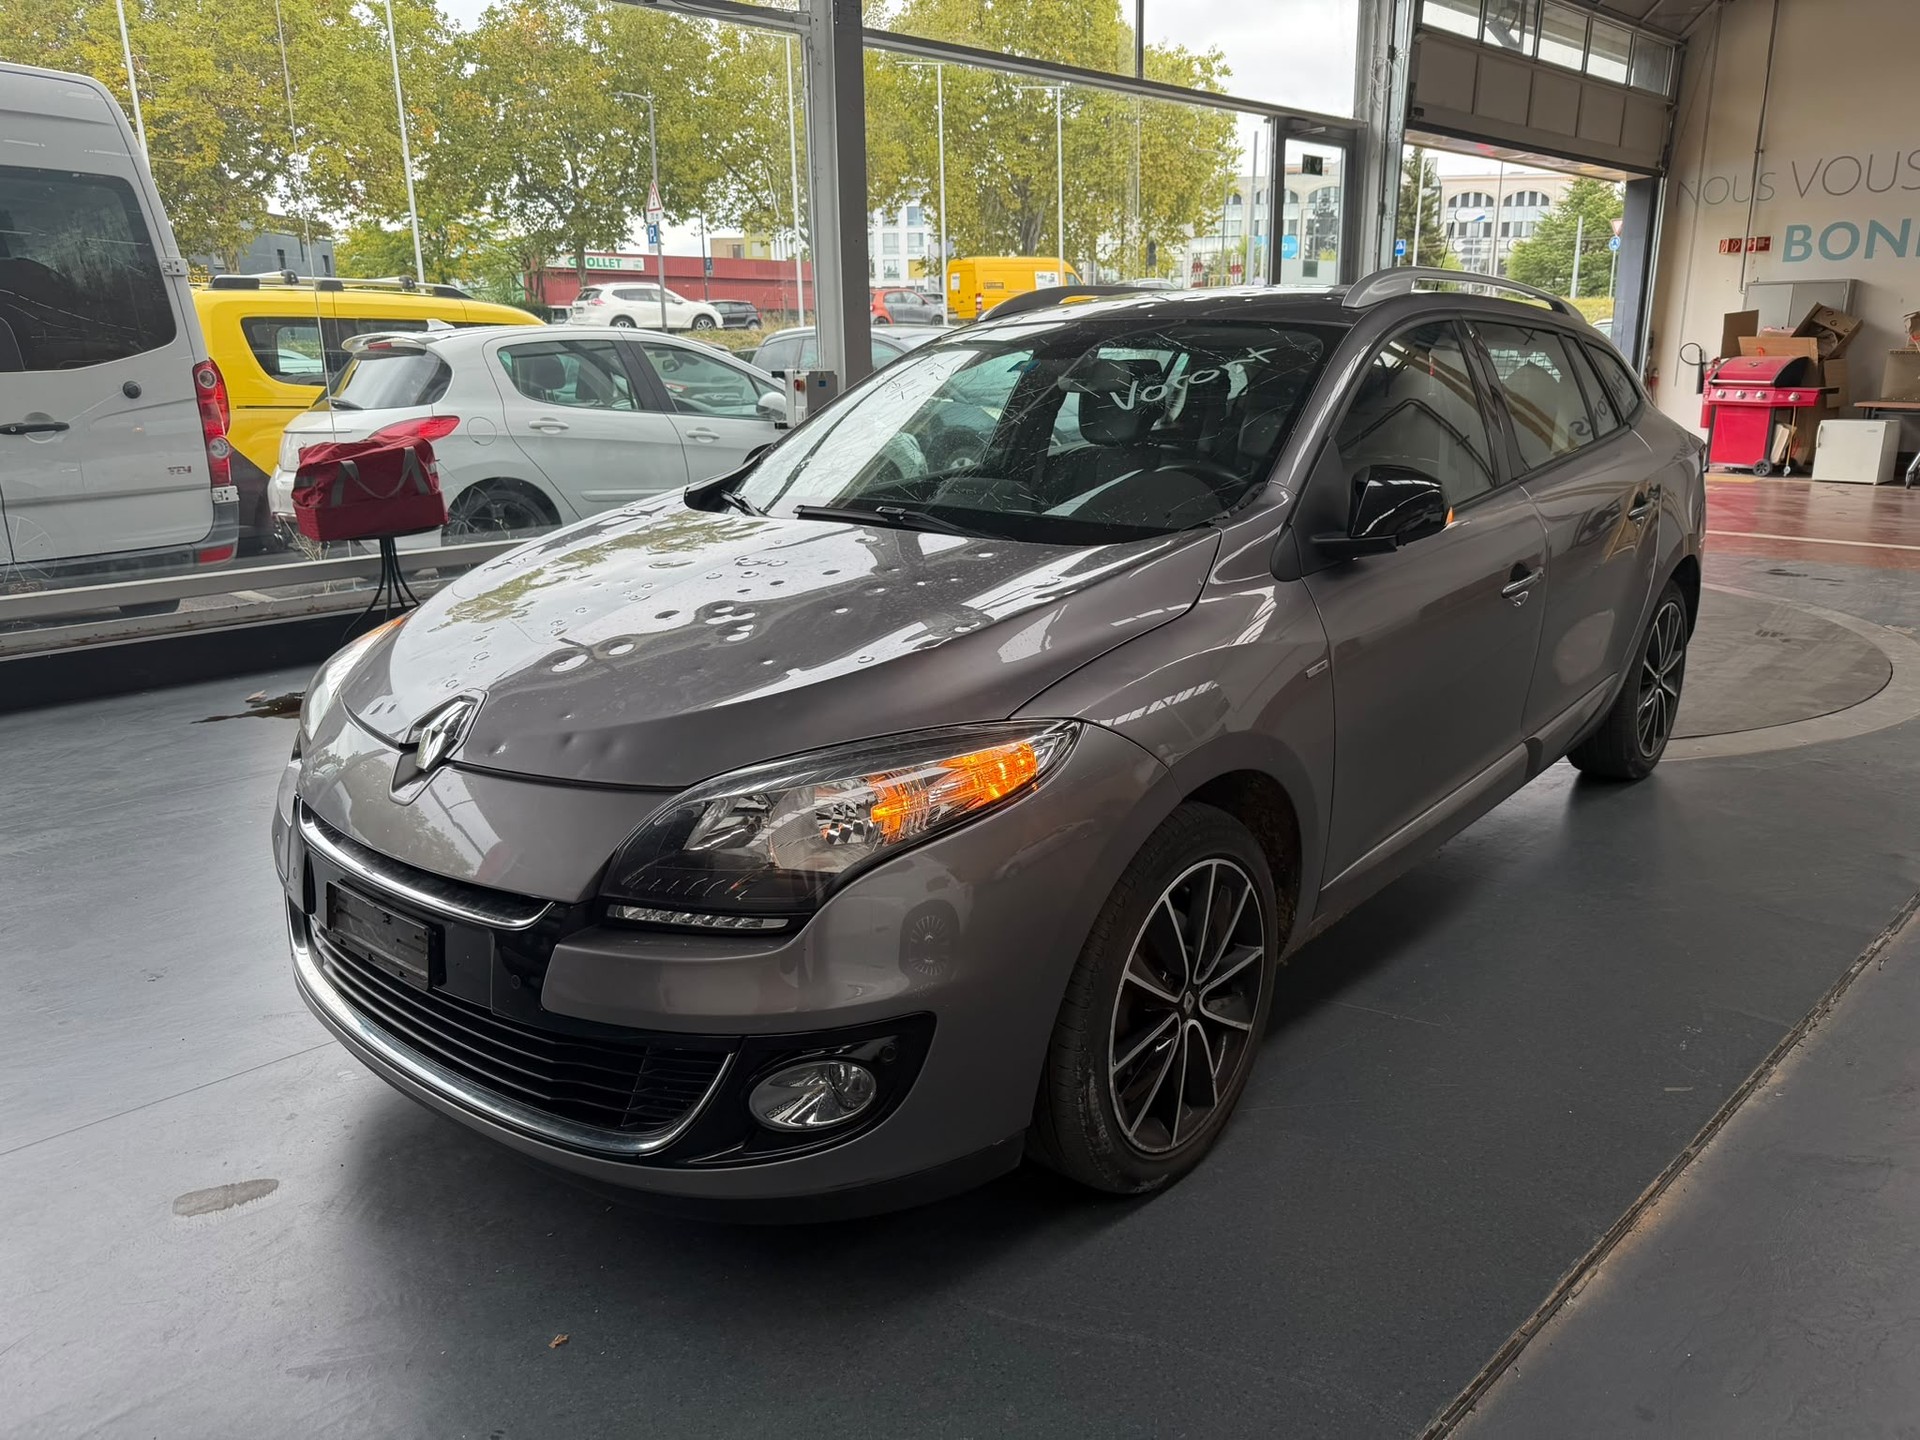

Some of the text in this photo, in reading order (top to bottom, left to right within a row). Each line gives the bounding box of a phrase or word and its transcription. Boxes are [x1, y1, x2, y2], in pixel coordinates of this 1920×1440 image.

[1676, 149, 1920, 207] NOUS VOUS
[567, 256, 622, 269] COLLET
